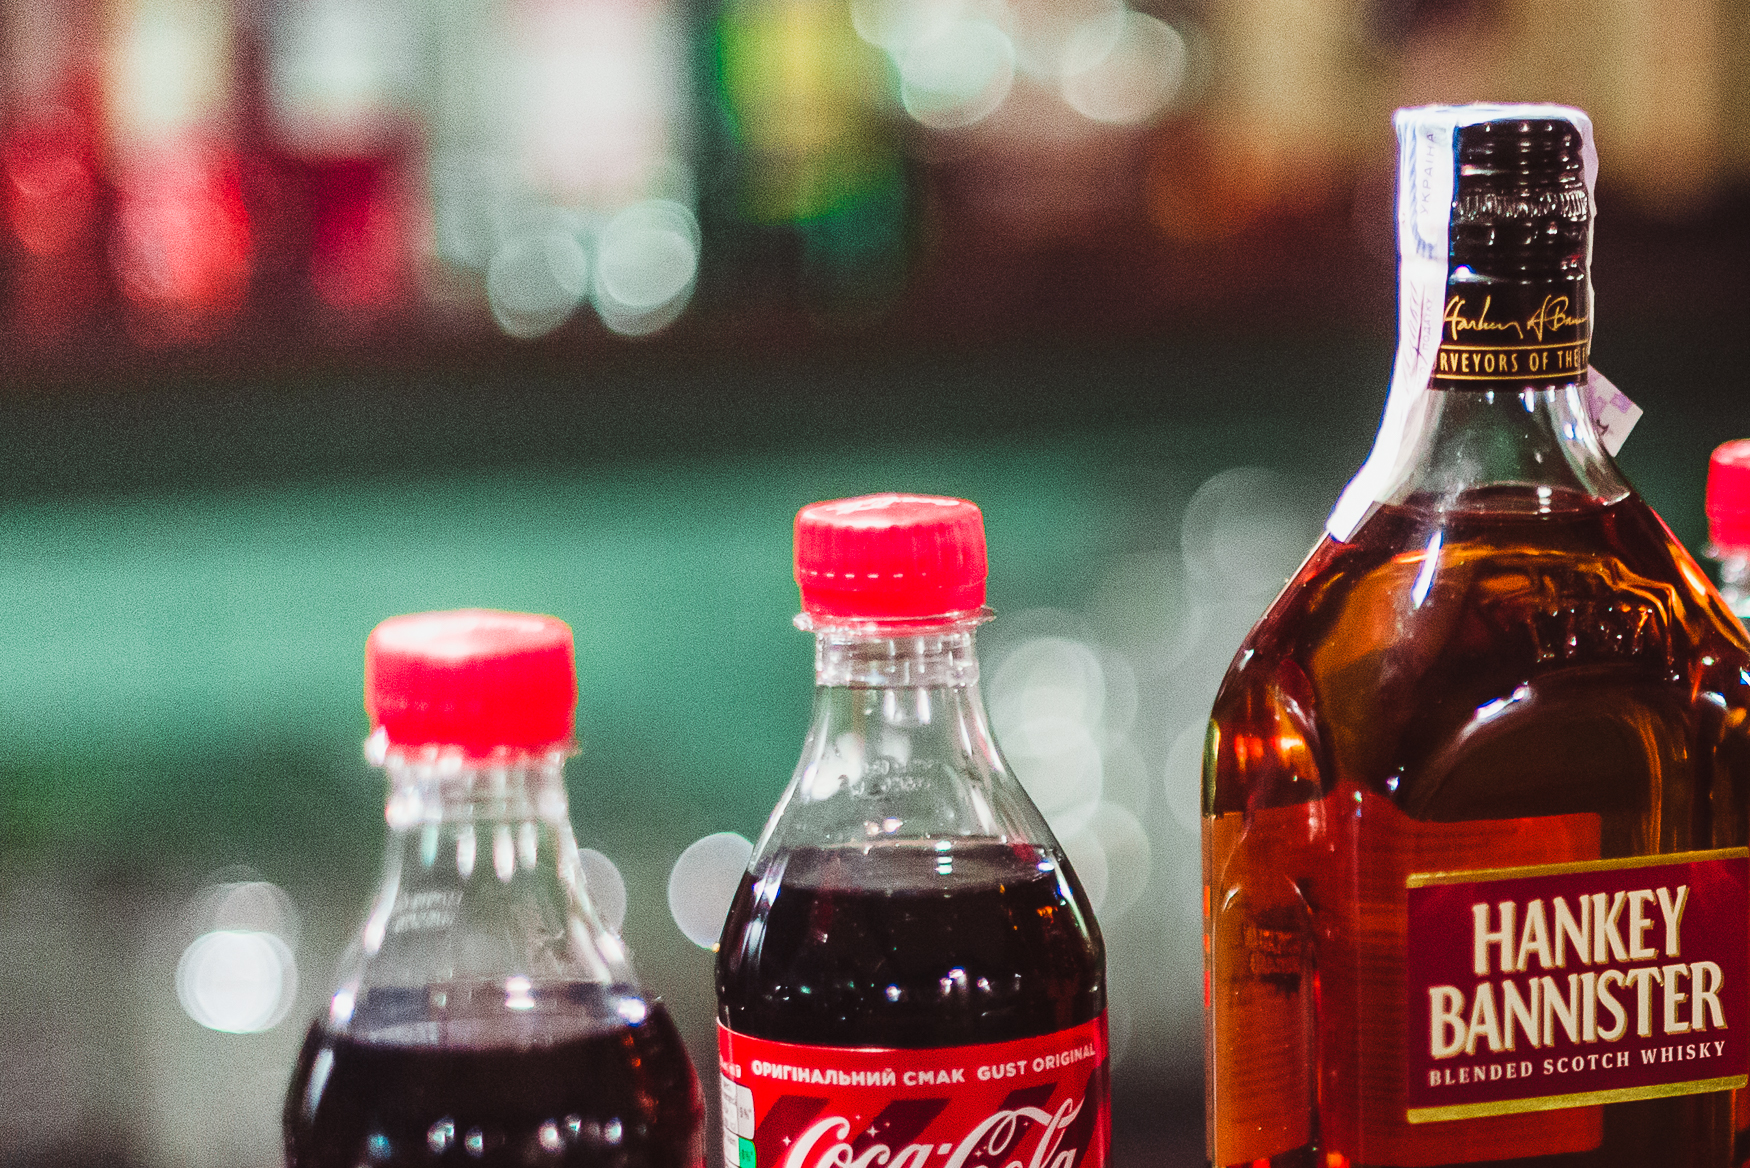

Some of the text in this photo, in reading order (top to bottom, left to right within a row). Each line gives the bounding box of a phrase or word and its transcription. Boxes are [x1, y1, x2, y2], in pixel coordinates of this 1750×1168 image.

[1436, 351, 1518, 373] RVEYORS
[1529, 352, 1548, 371] OF
[1557, 348, 1579, 368] THE
[1472, 885, 1688, 977] HANKEY
[1428, 960, 1728, 1060] BANNISTER
[751, 1059, 897, 1087] ОРИГІНАЛЬНИЙ
[902, 1067, 966, 1087] СМАК
[976, 1060, 1028, 1082] GUST
[1031, 1040, 1097, 1073] ORIGINAL
[1429, 1040, 1727, 1087] BLENDED SCOTCH WHISKY
